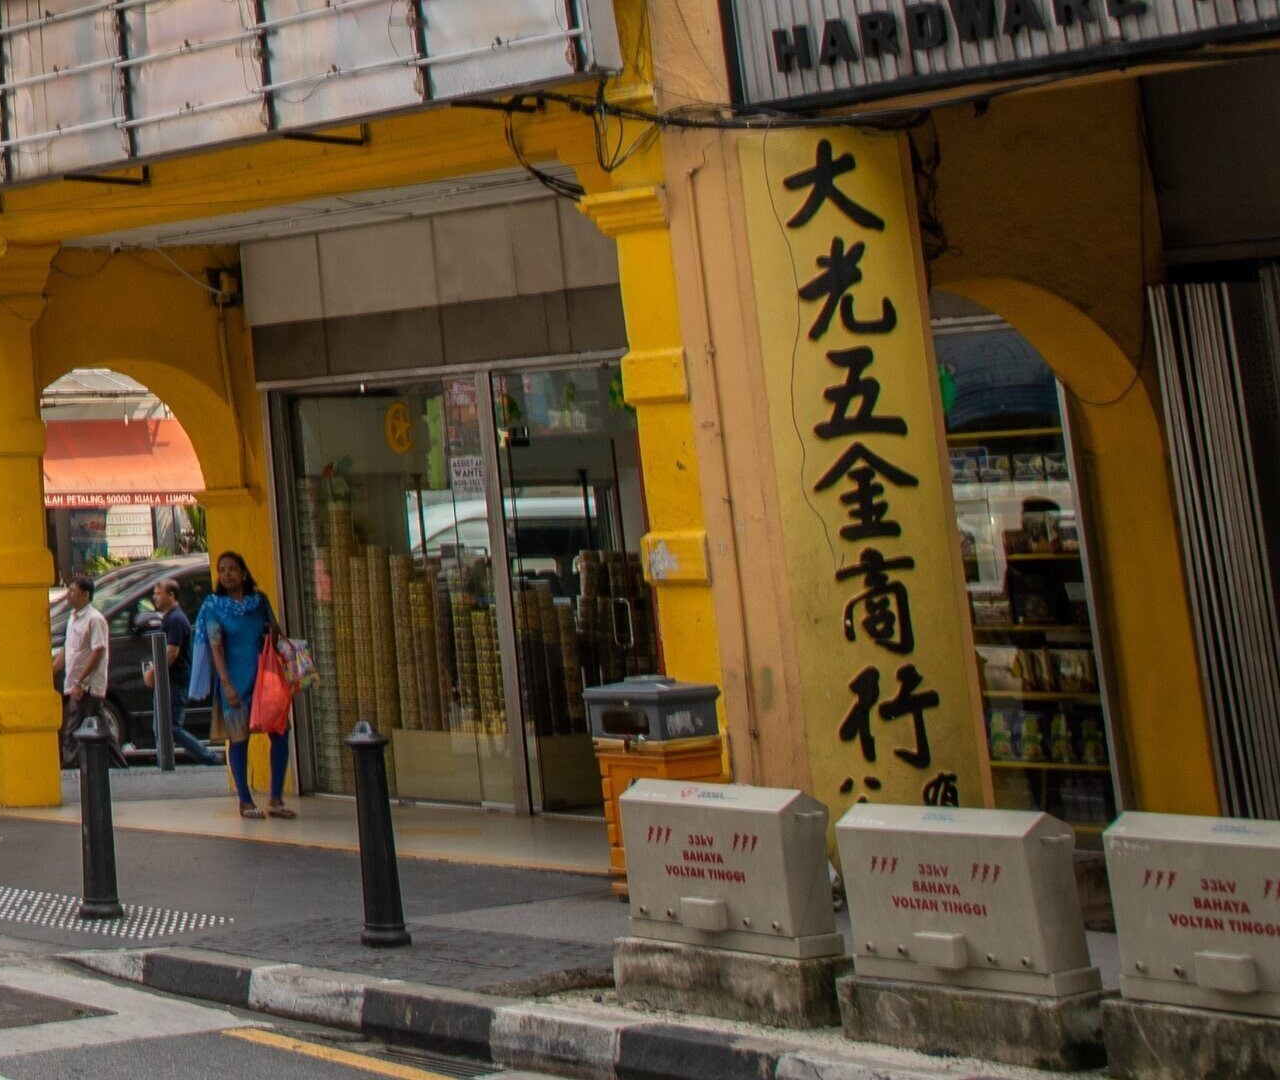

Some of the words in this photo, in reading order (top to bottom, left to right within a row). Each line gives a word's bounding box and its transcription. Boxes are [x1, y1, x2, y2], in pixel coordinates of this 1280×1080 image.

[782, 137, 940, 770] 大光五金商行
[66, 494, 106, 505] PETALING,
[106, 494, 131, 504] 50000
[135, 494, 161, 503] KUALA
[687, 834, 714, 847] 33kV
[682, 850, 724, 864] BAHAYA
[665, 864, 705, 879] VOLTAN
[707, 868, 746, 883] TINGGI
[918, 863, 949, 878] 33kV
[912, 880, 961, 897] BAHAYA
[1200, 878, 1237, 894] 33kV
[892, 896, 938, 912] VOLTAN
[941, 900, 988, 917] TINGGI
[1193, 896, 1251, 915] BAHAYA
[1168, 913, 1225, 931] VOLTAN
[1228, 919, 1280, 938] TINGGI
